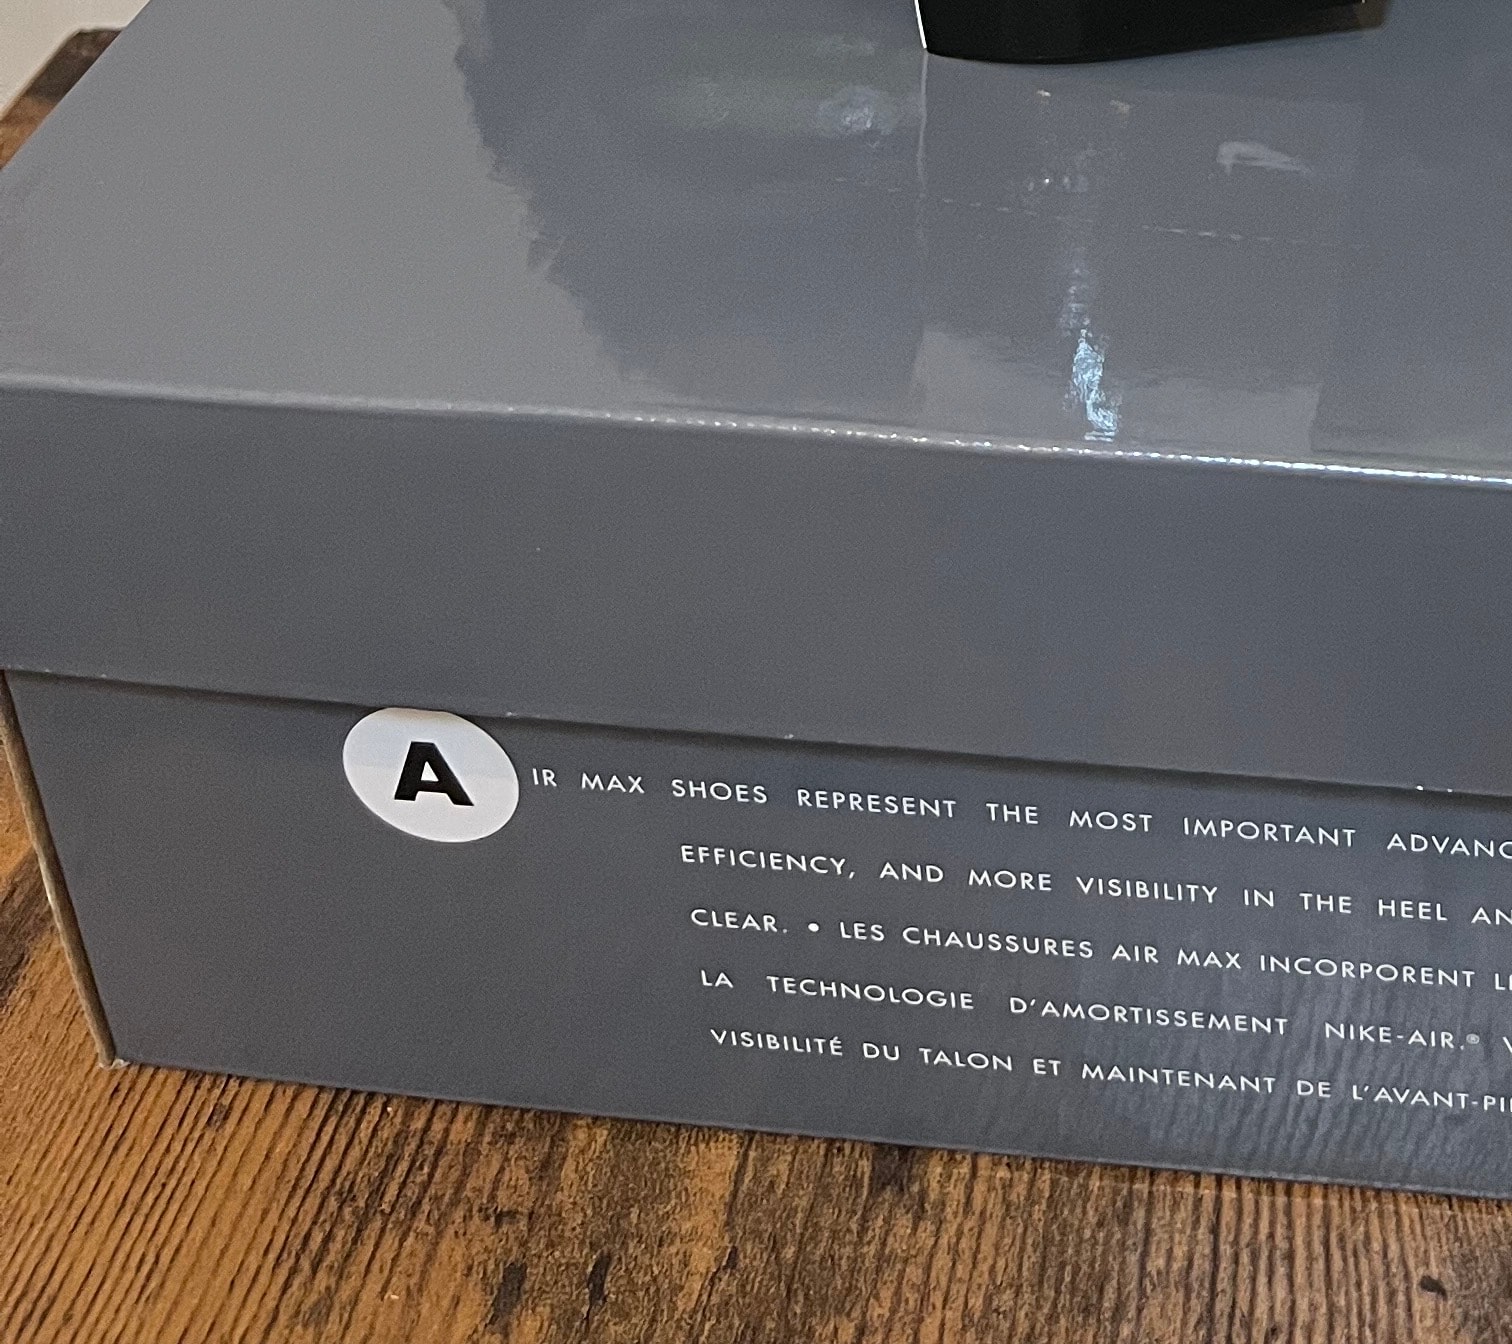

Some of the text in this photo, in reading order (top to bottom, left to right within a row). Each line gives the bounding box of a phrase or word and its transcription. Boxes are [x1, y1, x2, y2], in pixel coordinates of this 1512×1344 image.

[393, 741, 475, 807] A
[531, 767, 558, 788] IR
[580, 772, 645, 795] MAX
[671, 778, 768, 805] SHOES
[796, 788, 957, 819] REPRESENT
[985, 802, 1039, 825] THE
[1069, 809, 1153, 833] MOST
[1183, 816, 1357, 848] IMPORTANT
[680, 844, 856, 880] EFFICIENCY,
[879, 861, 944, 883] AND
[968, 868, 1053, 892] MORE
[1075, 875, 1218, 904] VISIBILITY
[1243, 888, 1275, 908] IN
[1298, 892, 1352, 915] THE
[1377, 898, 1448, 922] HEEL
[690, 908, 788, 934] CLEAR.
[839, 921, 885, 942] LES
[901, 926, 1094, 959] CHAUSSURES
[1111, 943, 1159, 964] AIR
[1176, 948, 1242, 970] MAX
[1259, 954, 1476, 988] INCORPORENT
[700, 969, 734, 989] LA
[765, 975, 975, 1011] TECHNOLOGIE
[709, 1028, 844, 1057] VISIBILITÉ
[862, 1042, 900, 1062] DU
[918, 1047, 1013, 1072] TALON
[1032, 1058, 1062, 1077] ET
[1081, 1063, 1276, 1094] MAINTENANT
[1296, 1079, 1333, 1099] DE
